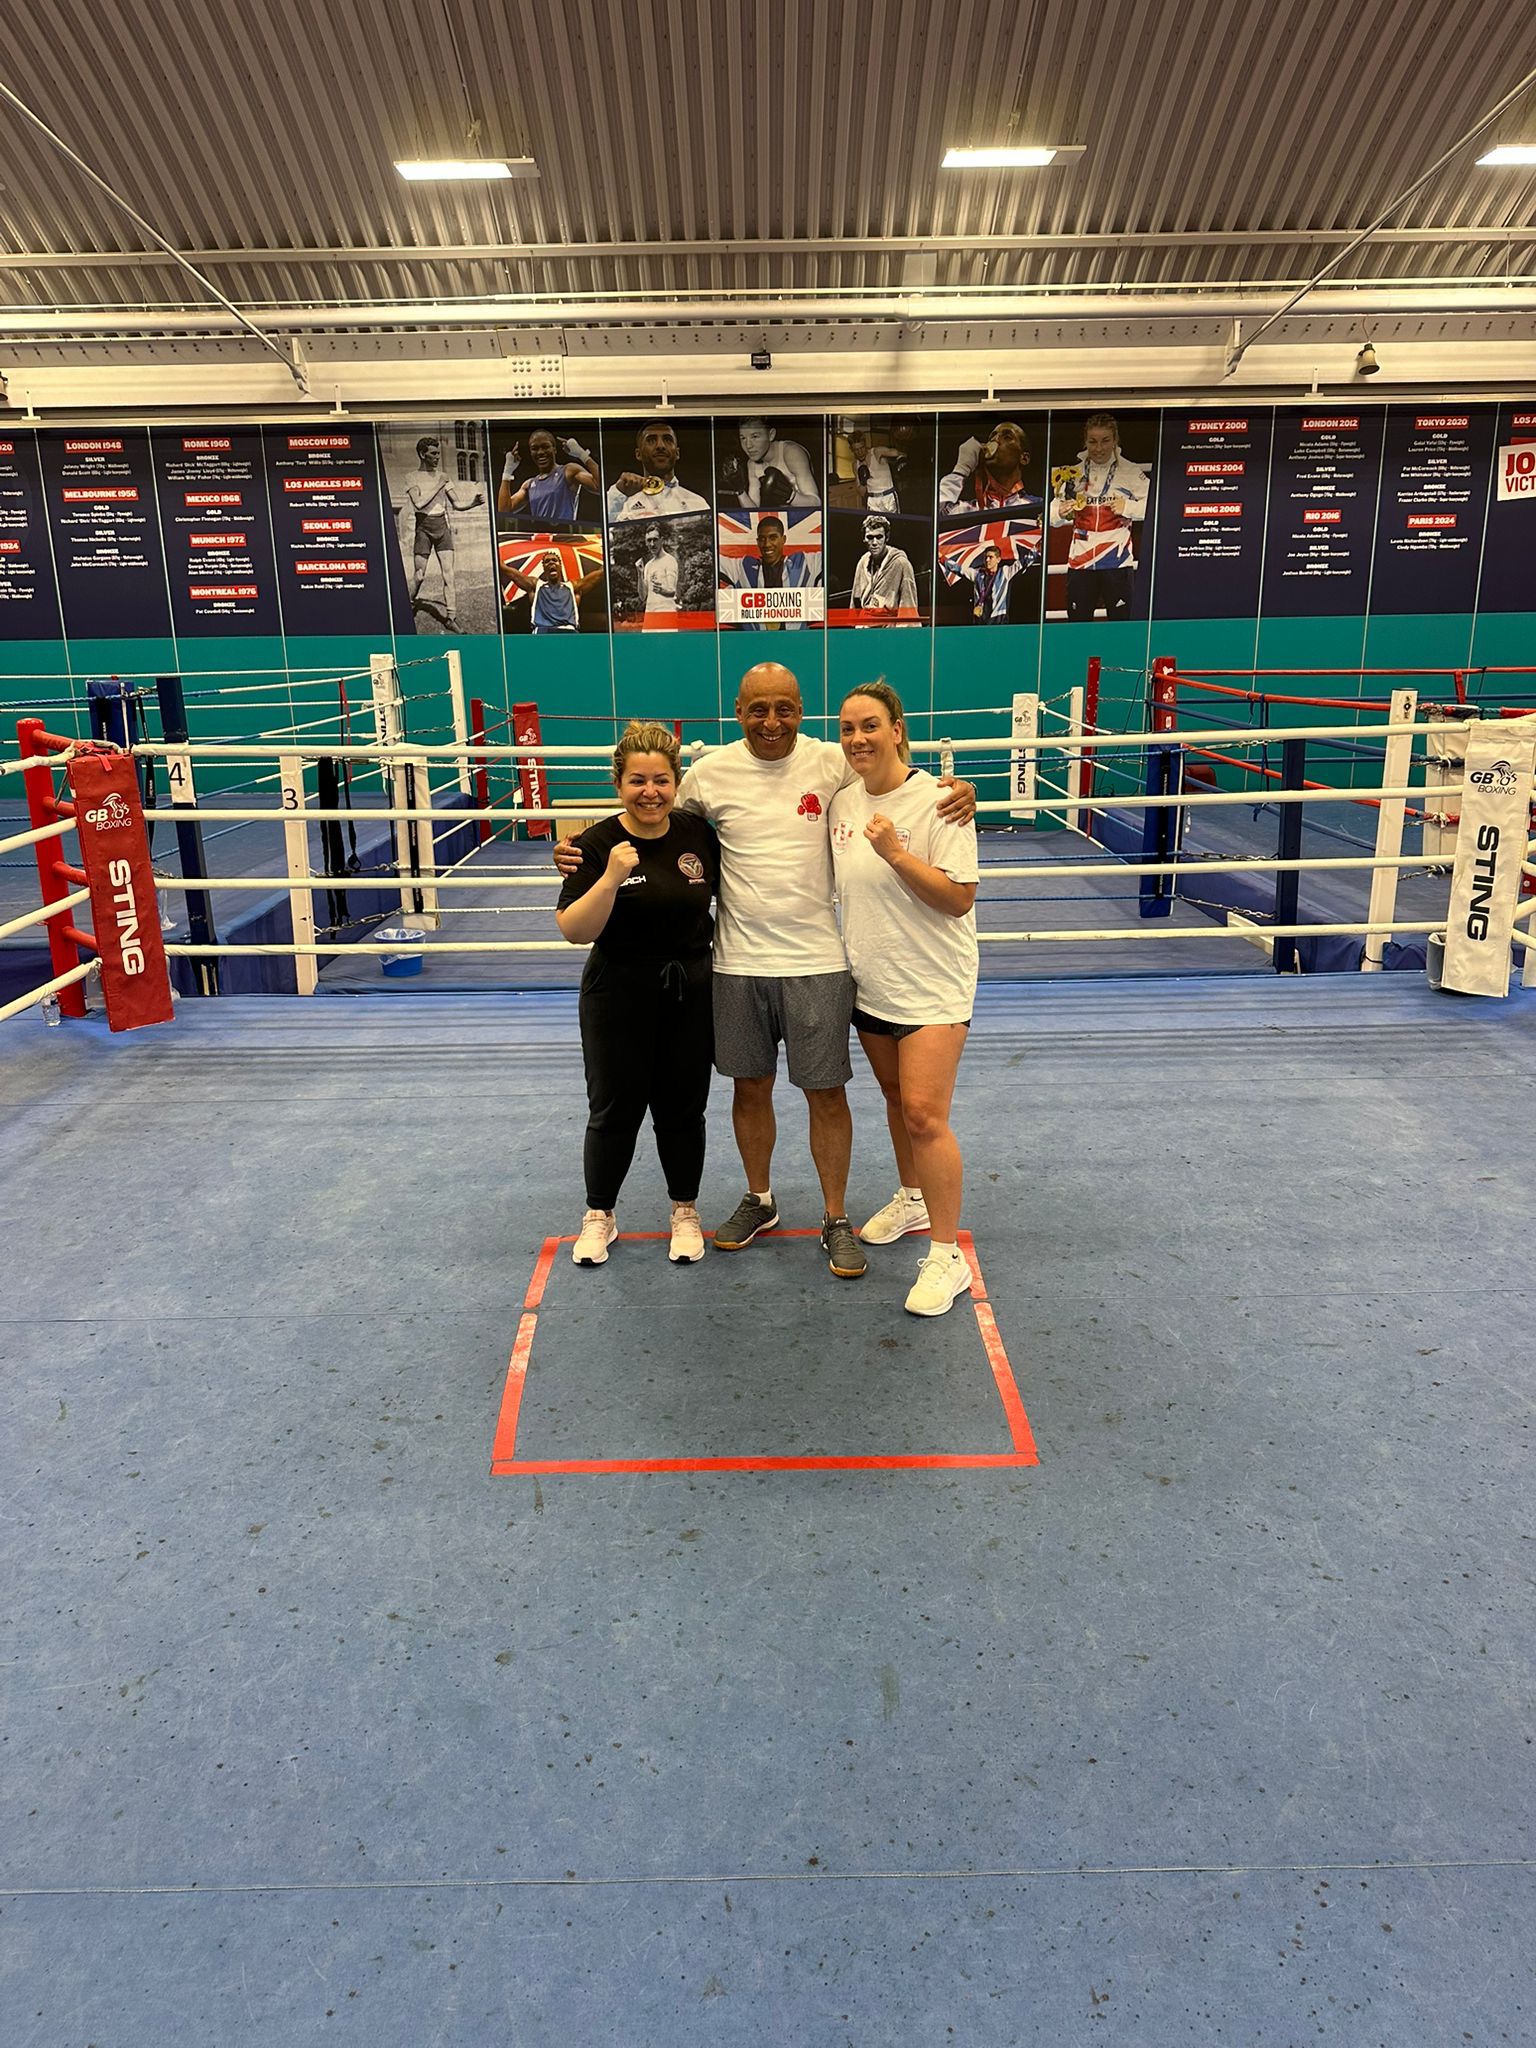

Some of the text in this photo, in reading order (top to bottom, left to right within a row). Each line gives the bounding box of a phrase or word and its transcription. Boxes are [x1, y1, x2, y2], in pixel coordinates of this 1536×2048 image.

[1303, 420, 1339, 428] LONDON
[1417, 419, 1446, 427] TOKYO
[66, 442, 102, 450] LONDON
[1188, 465, 1221, 473] ATHENS
[286, 480, 361, 489] LOS ANGELES 1984
[64, 490, 137, 499] MELBOURNE 1956
[187, 495, 220, 503] MEXICO
[1186, 506, 1219, 514] BEIJING
[1409, 517, 1434, 525] PARIS
[304, 522, 331, 530] SEOUL
[297, 563, 347, 571] BARCELONA
[192, 588, 238, 596] MONTREAL
[741, 609, 802, 619] ROLL OF HONOUR
[169, 762, 186, 787] 4
[1470, 771, 1494, 786] GB
[1477, 784, 1517, 796] BOXING
[283, 788, 299, 810] 3
[85, 809, 108, 823] GB
[96, 818, 132, 831] BOXING
[1467, 825, 1500, 941] STING
[108, 859, 145, 977] STING
